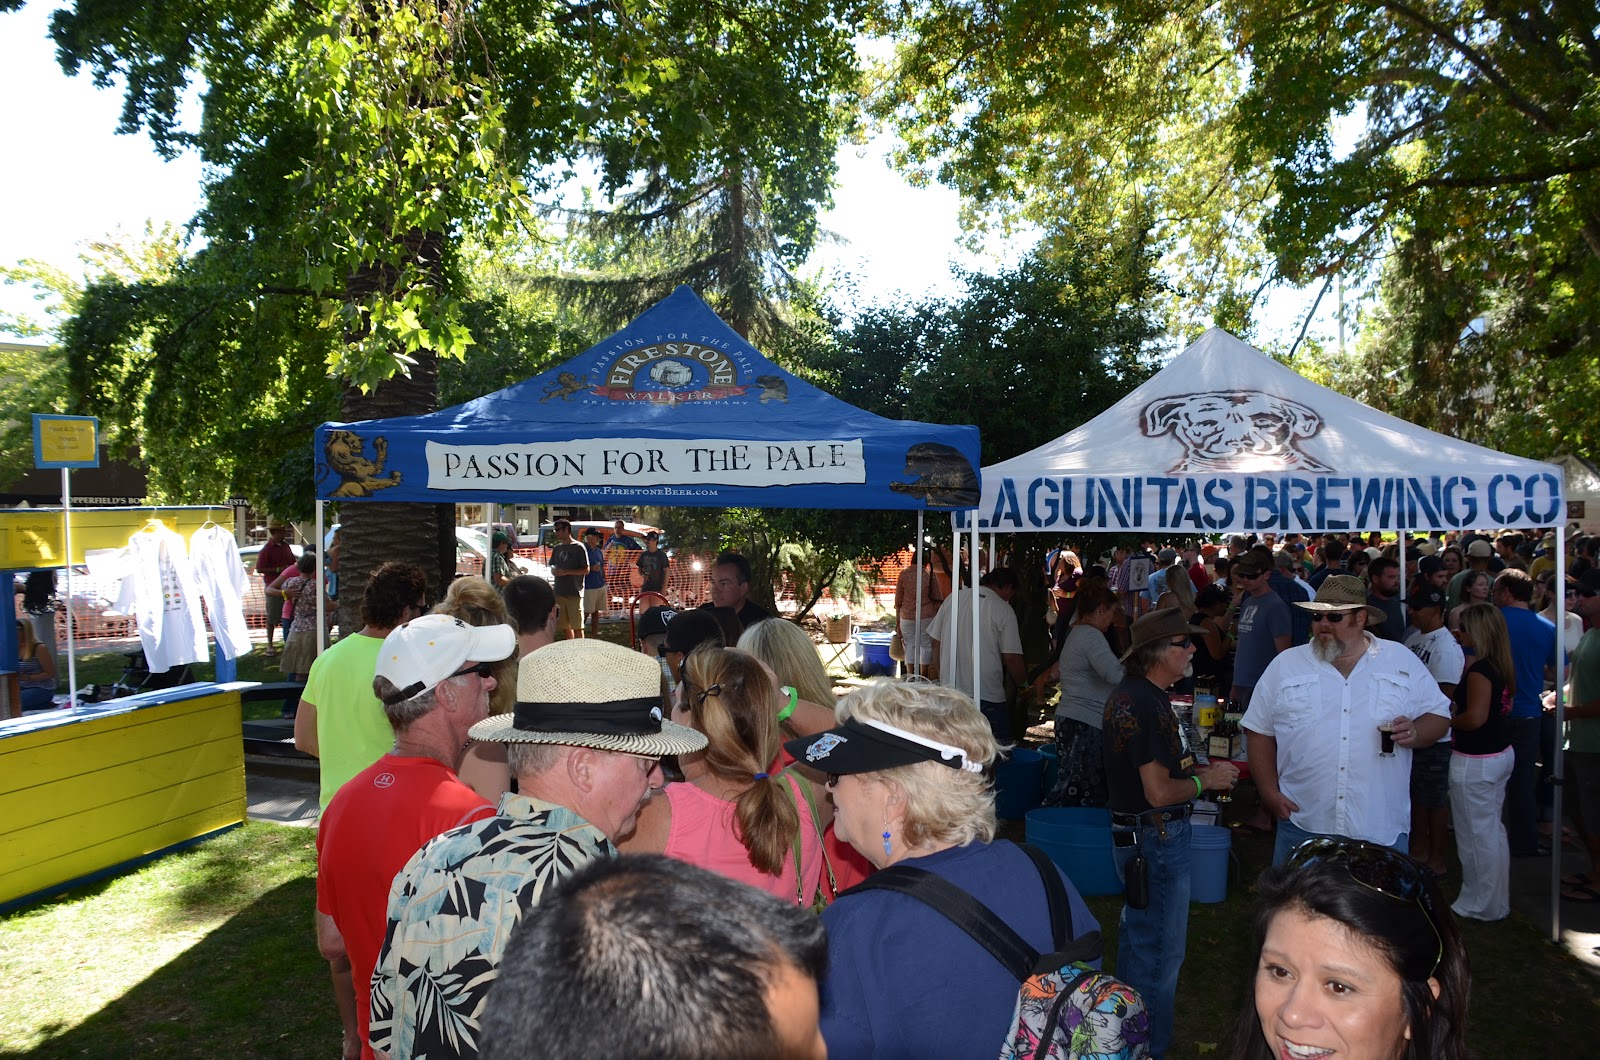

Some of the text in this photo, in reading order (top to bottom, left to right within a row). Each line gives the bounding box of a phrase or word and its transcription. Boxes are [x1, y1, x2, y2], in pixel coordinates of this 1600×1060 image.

[591, 333, 753, 375] PASSION FOR THE PALE
[610, 343, 733, 385] FIRESTONE
[624, 392, 713, 400] WALKER
[444, 444, 846, 479] PASSION FOR THE PALE
[60, 496, 126, 504] OPPERFIELD'S
[1244, 475, 1478, 530] BREWING
[1487, 473, 1560, 525] CO
